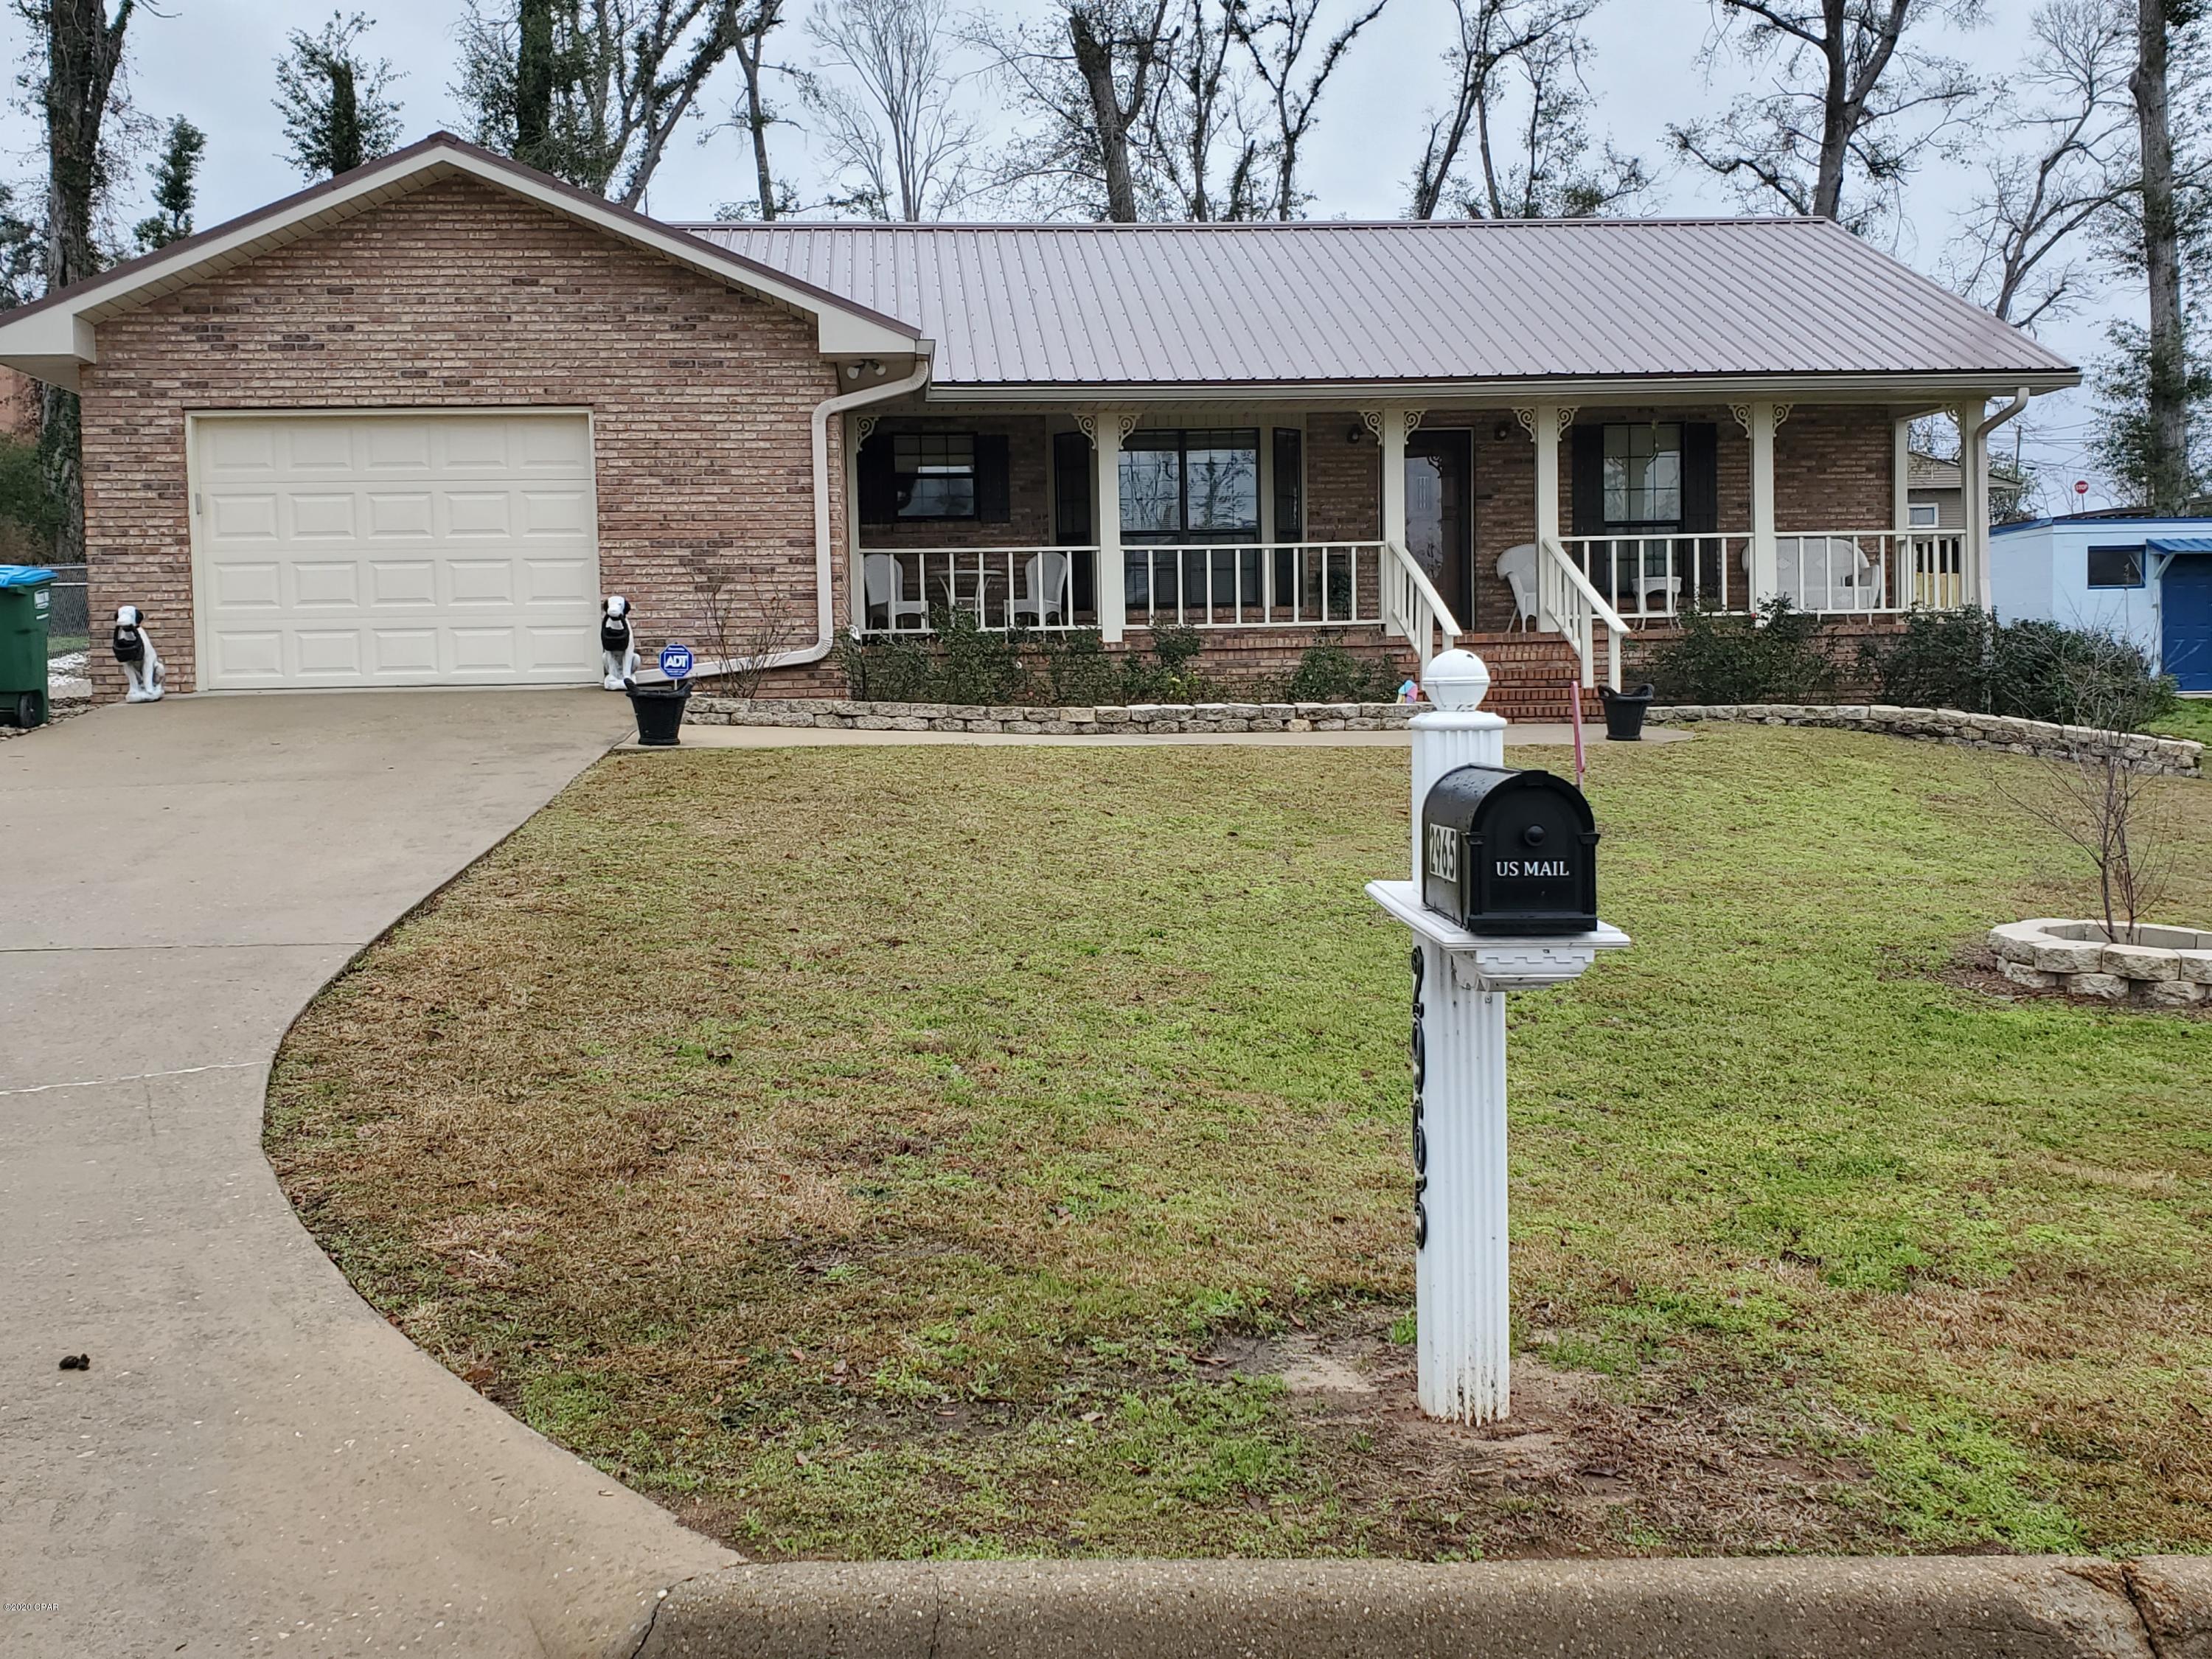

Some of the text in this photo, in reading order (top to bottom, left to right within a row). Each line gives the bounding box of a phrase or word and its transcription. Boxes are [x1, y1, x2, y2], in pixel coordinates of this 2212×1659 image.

[665, 655, 687, 667] ADT
[1430, 827, 1455, 878] 2965
[1496, 861, 1569, 876] US MAIL
